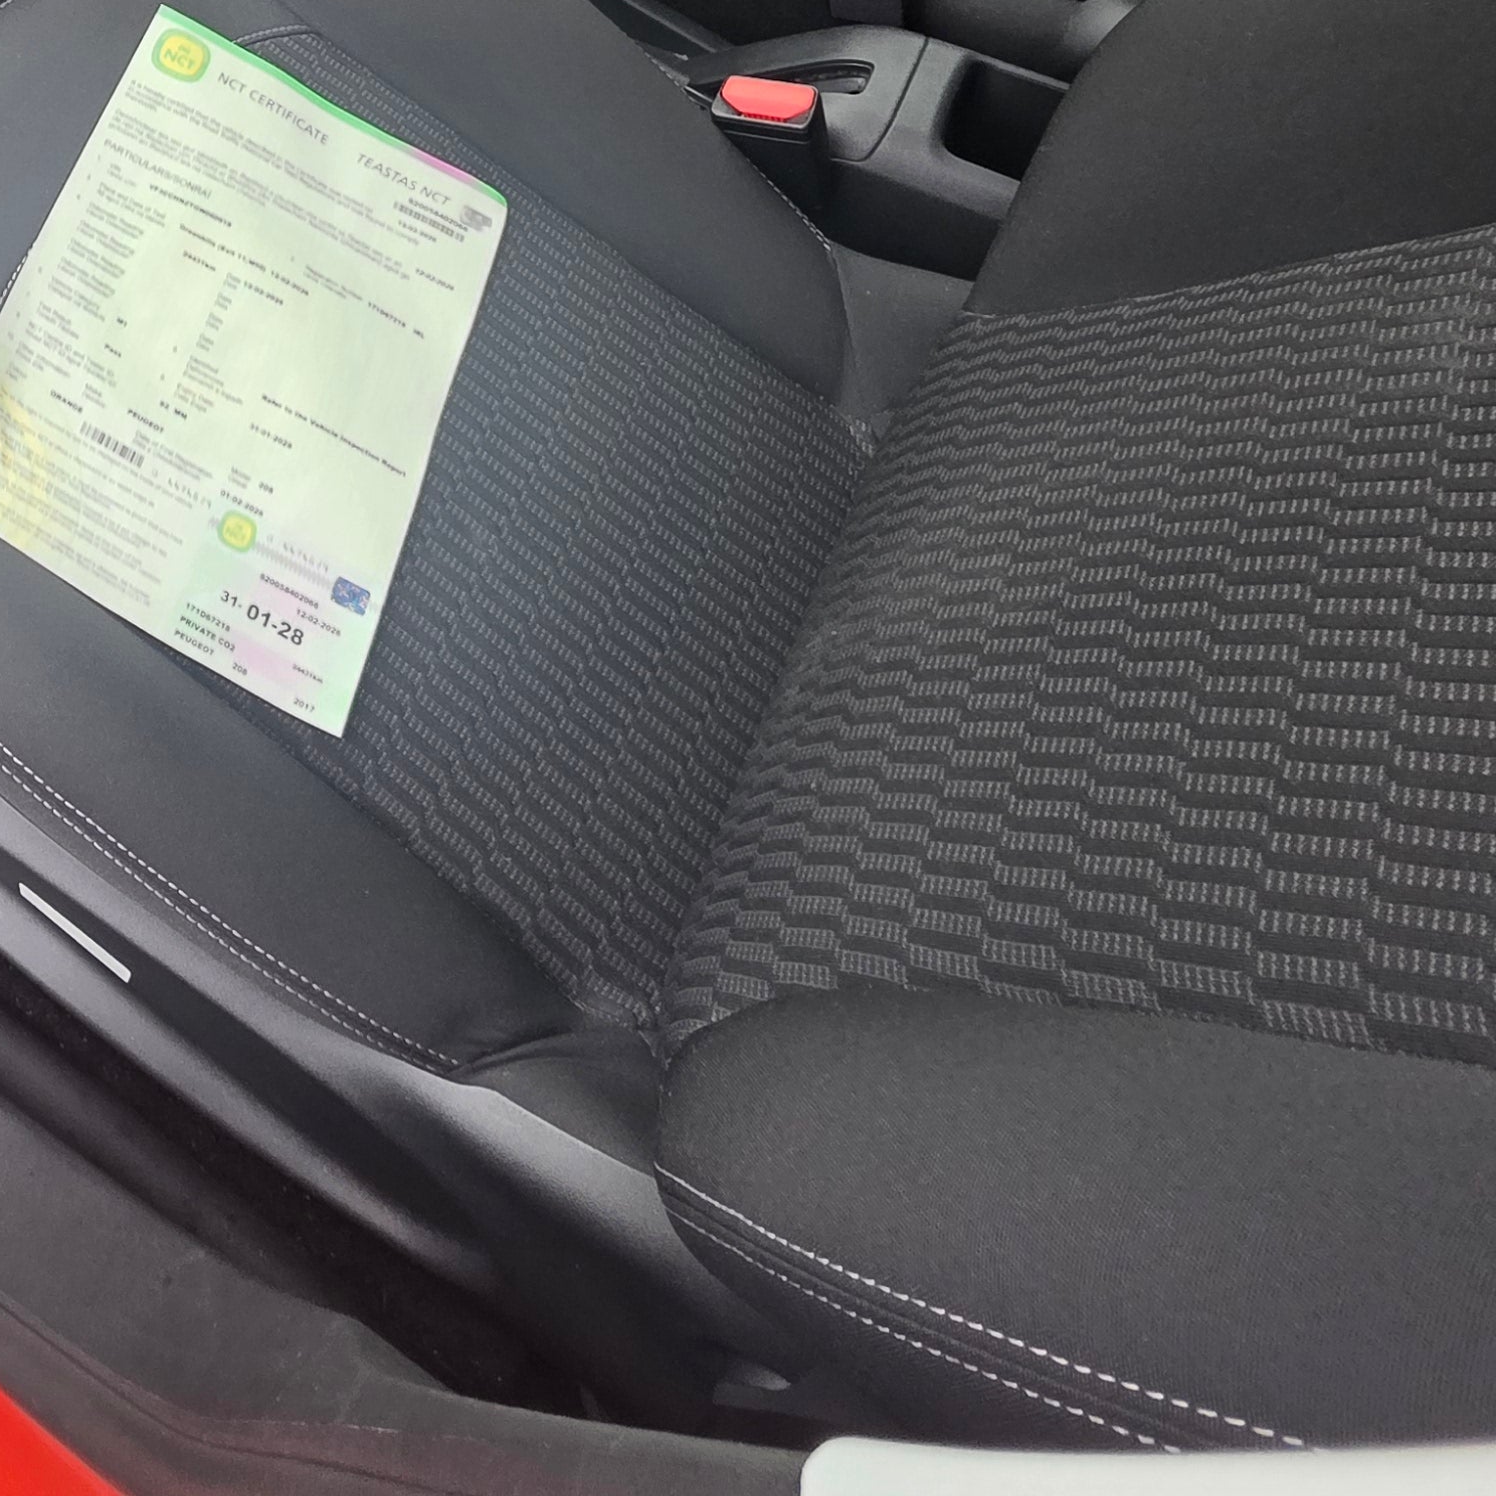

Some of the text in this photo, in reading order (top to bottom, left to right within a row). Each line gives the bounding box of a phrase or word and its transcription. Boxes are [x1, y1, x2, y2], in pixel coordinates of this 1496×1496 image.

[217, 72, 329, 145] NCT CERTIFICATE
[357, 154, 451, 205] TEASTAS NCT
[50, 390, 83, 413] ORANGE
[127, 409, 164, 433] PEUGEOT
[180, 615, 216, 640] PRIVATE
[247, 604, 304, 646] 01-28
[174, 629, 315, 712] PEUGEOT 208 2017
